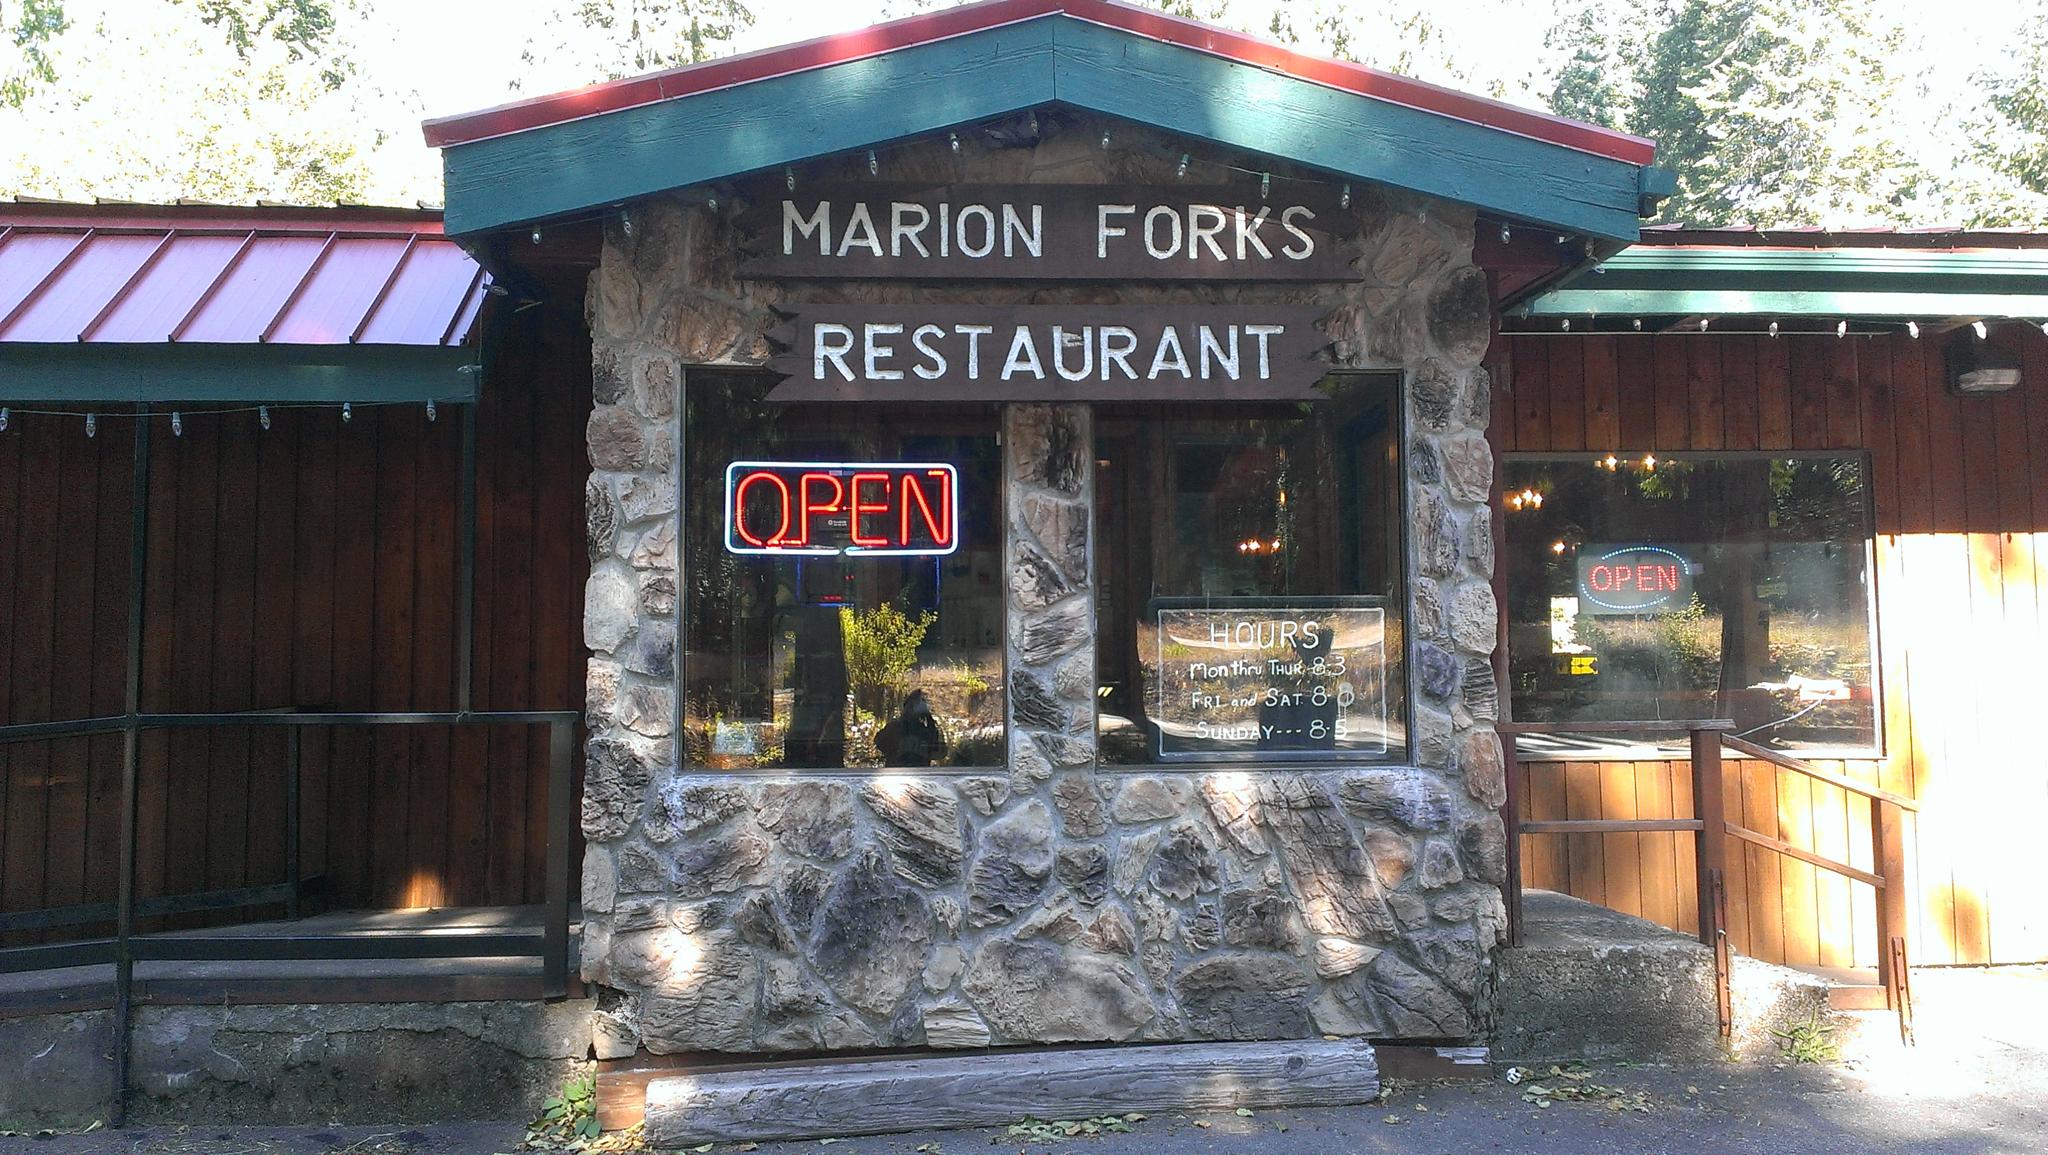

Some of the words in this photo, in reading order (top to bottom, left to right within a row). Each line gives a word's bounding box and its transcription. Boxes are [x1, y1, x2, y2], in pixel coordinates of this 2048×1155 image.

[782, 200, 1044, 259] MARION
[1097, 203, 1315, 261] FORKS
[813, 322, 1286, 382] RESTAURANT
[735, 472, 950, 546] OPEN
[1590, 565, 1679, 592] OPEN
[1210, 621, 1319, 649] HOURS
